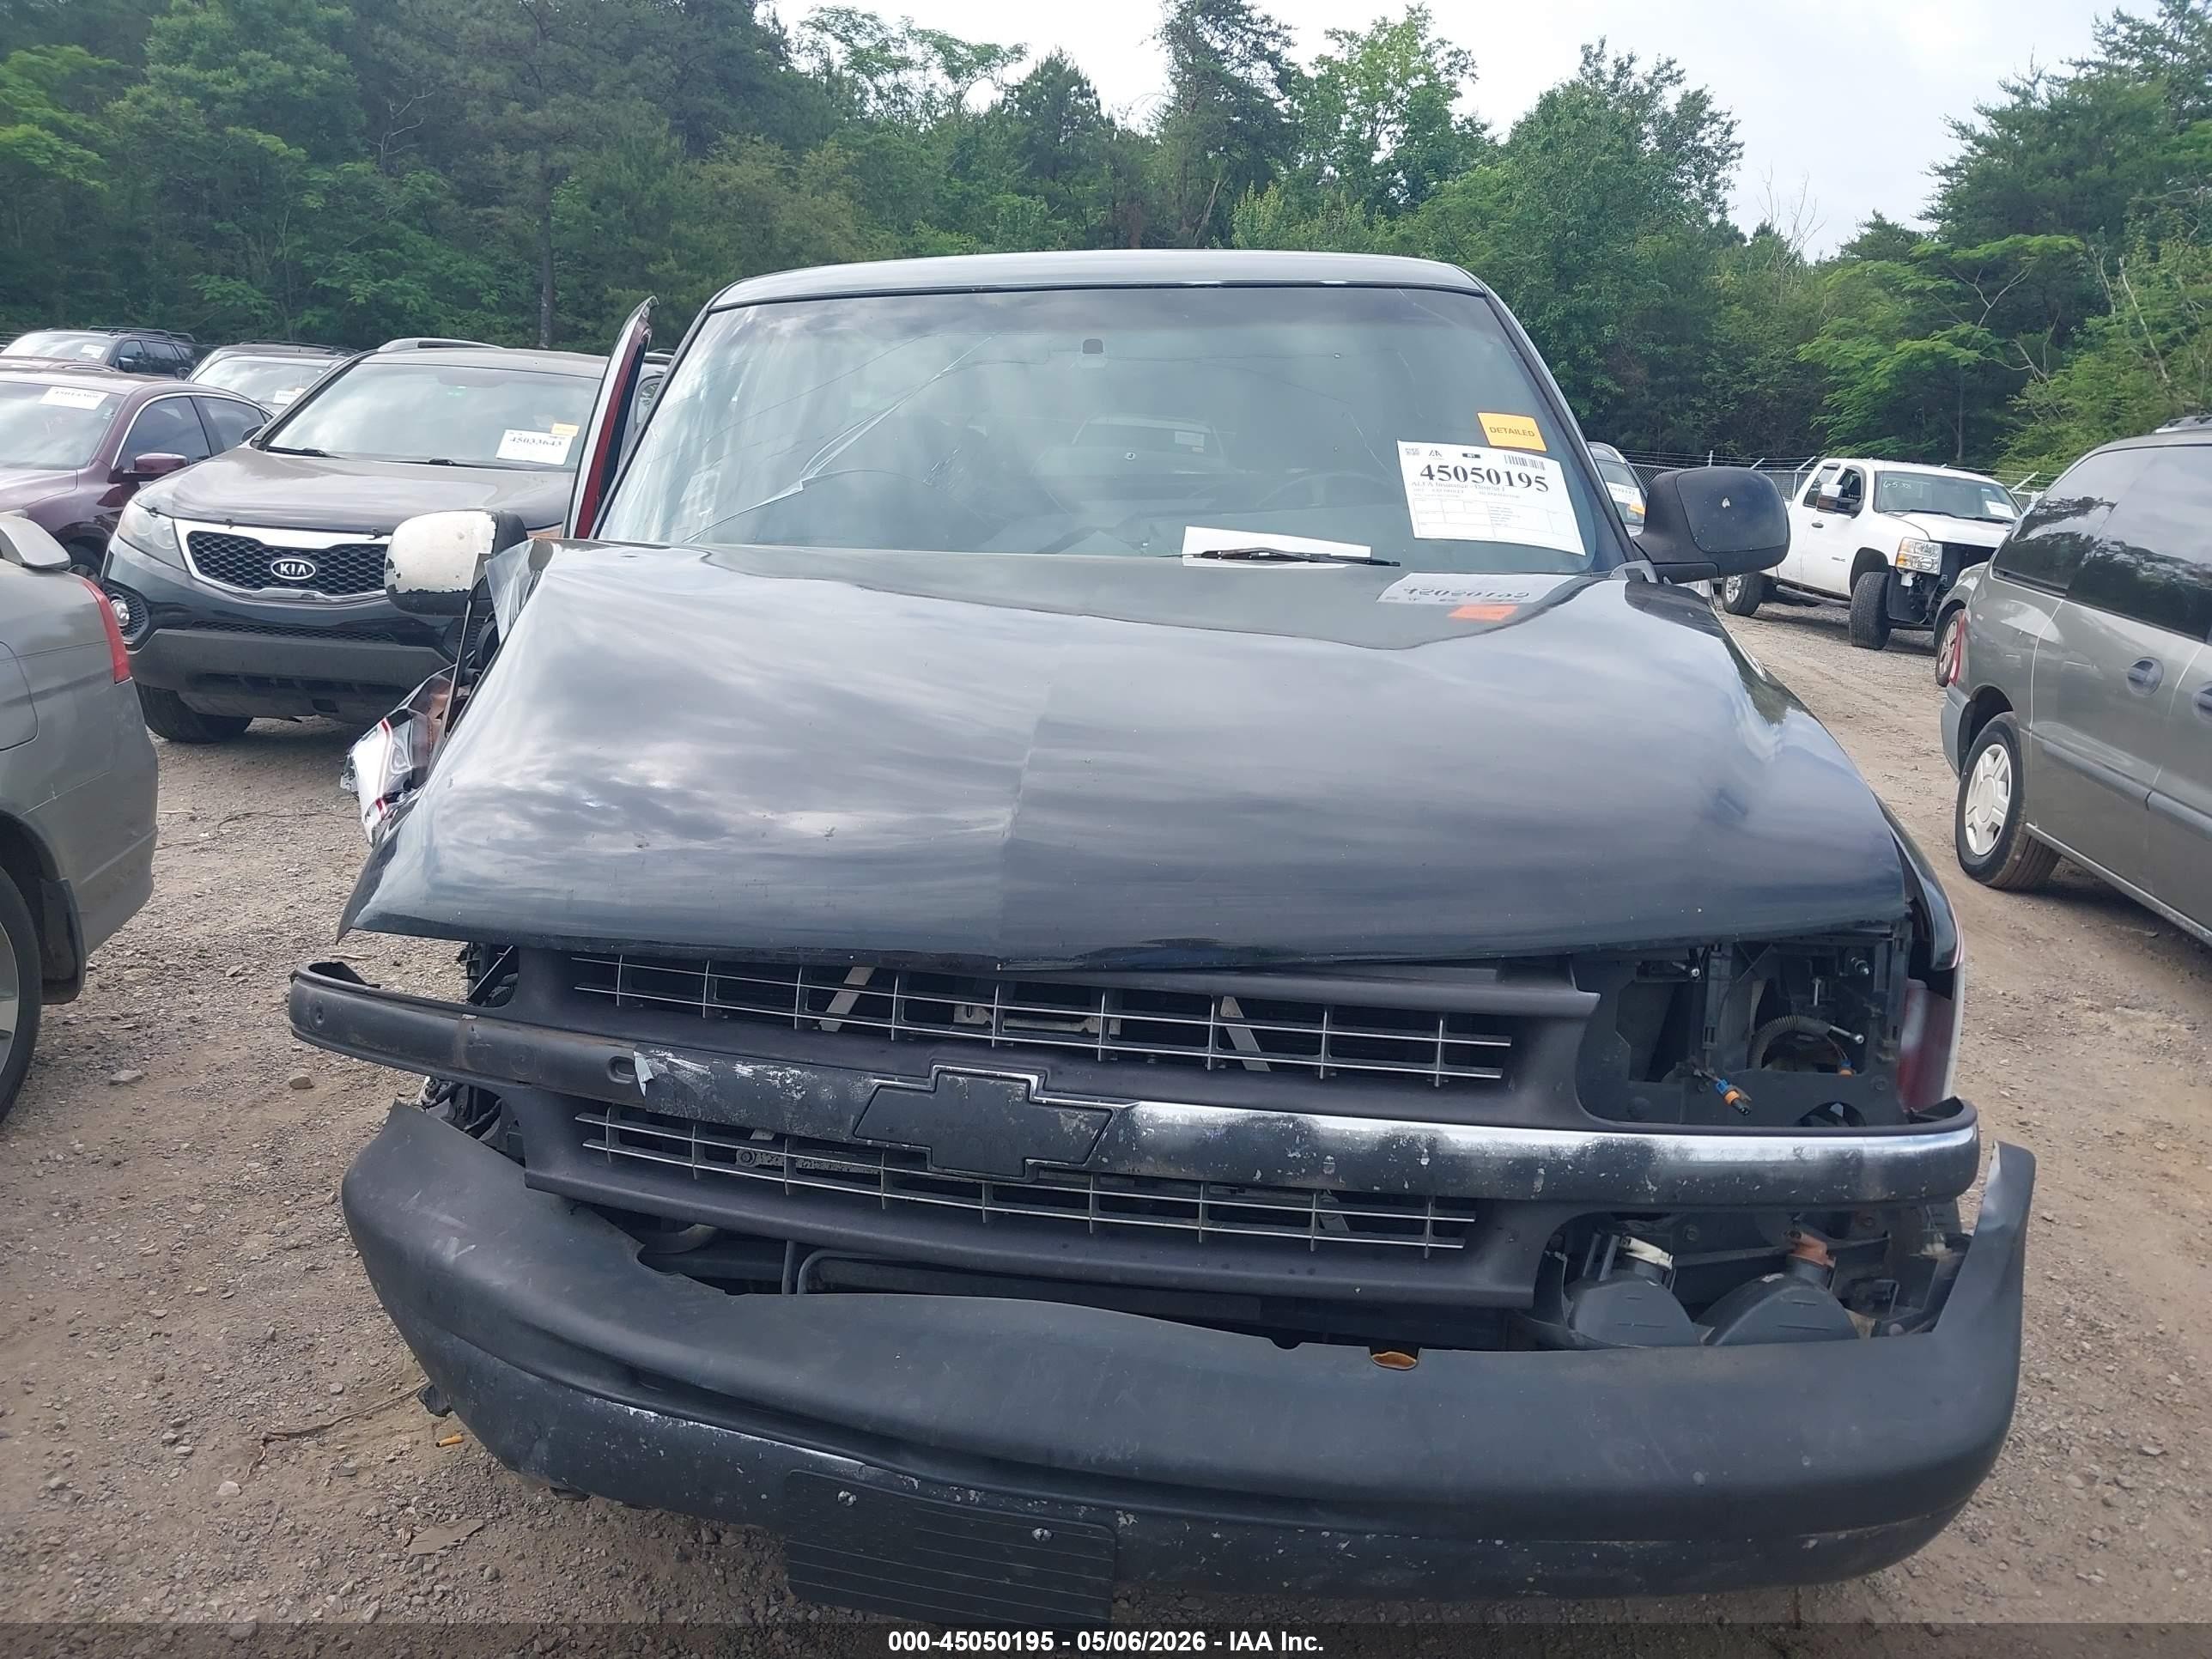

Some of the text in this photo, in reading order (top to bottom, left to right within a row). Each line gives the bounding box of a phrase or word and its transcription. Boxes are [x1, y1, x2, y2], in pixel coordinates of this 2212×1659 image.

[1489, 426, 1535, 437] DETAILED
[1419, 464, 1549, 493] 45050195
[280, 563, 307, 575] KIA
